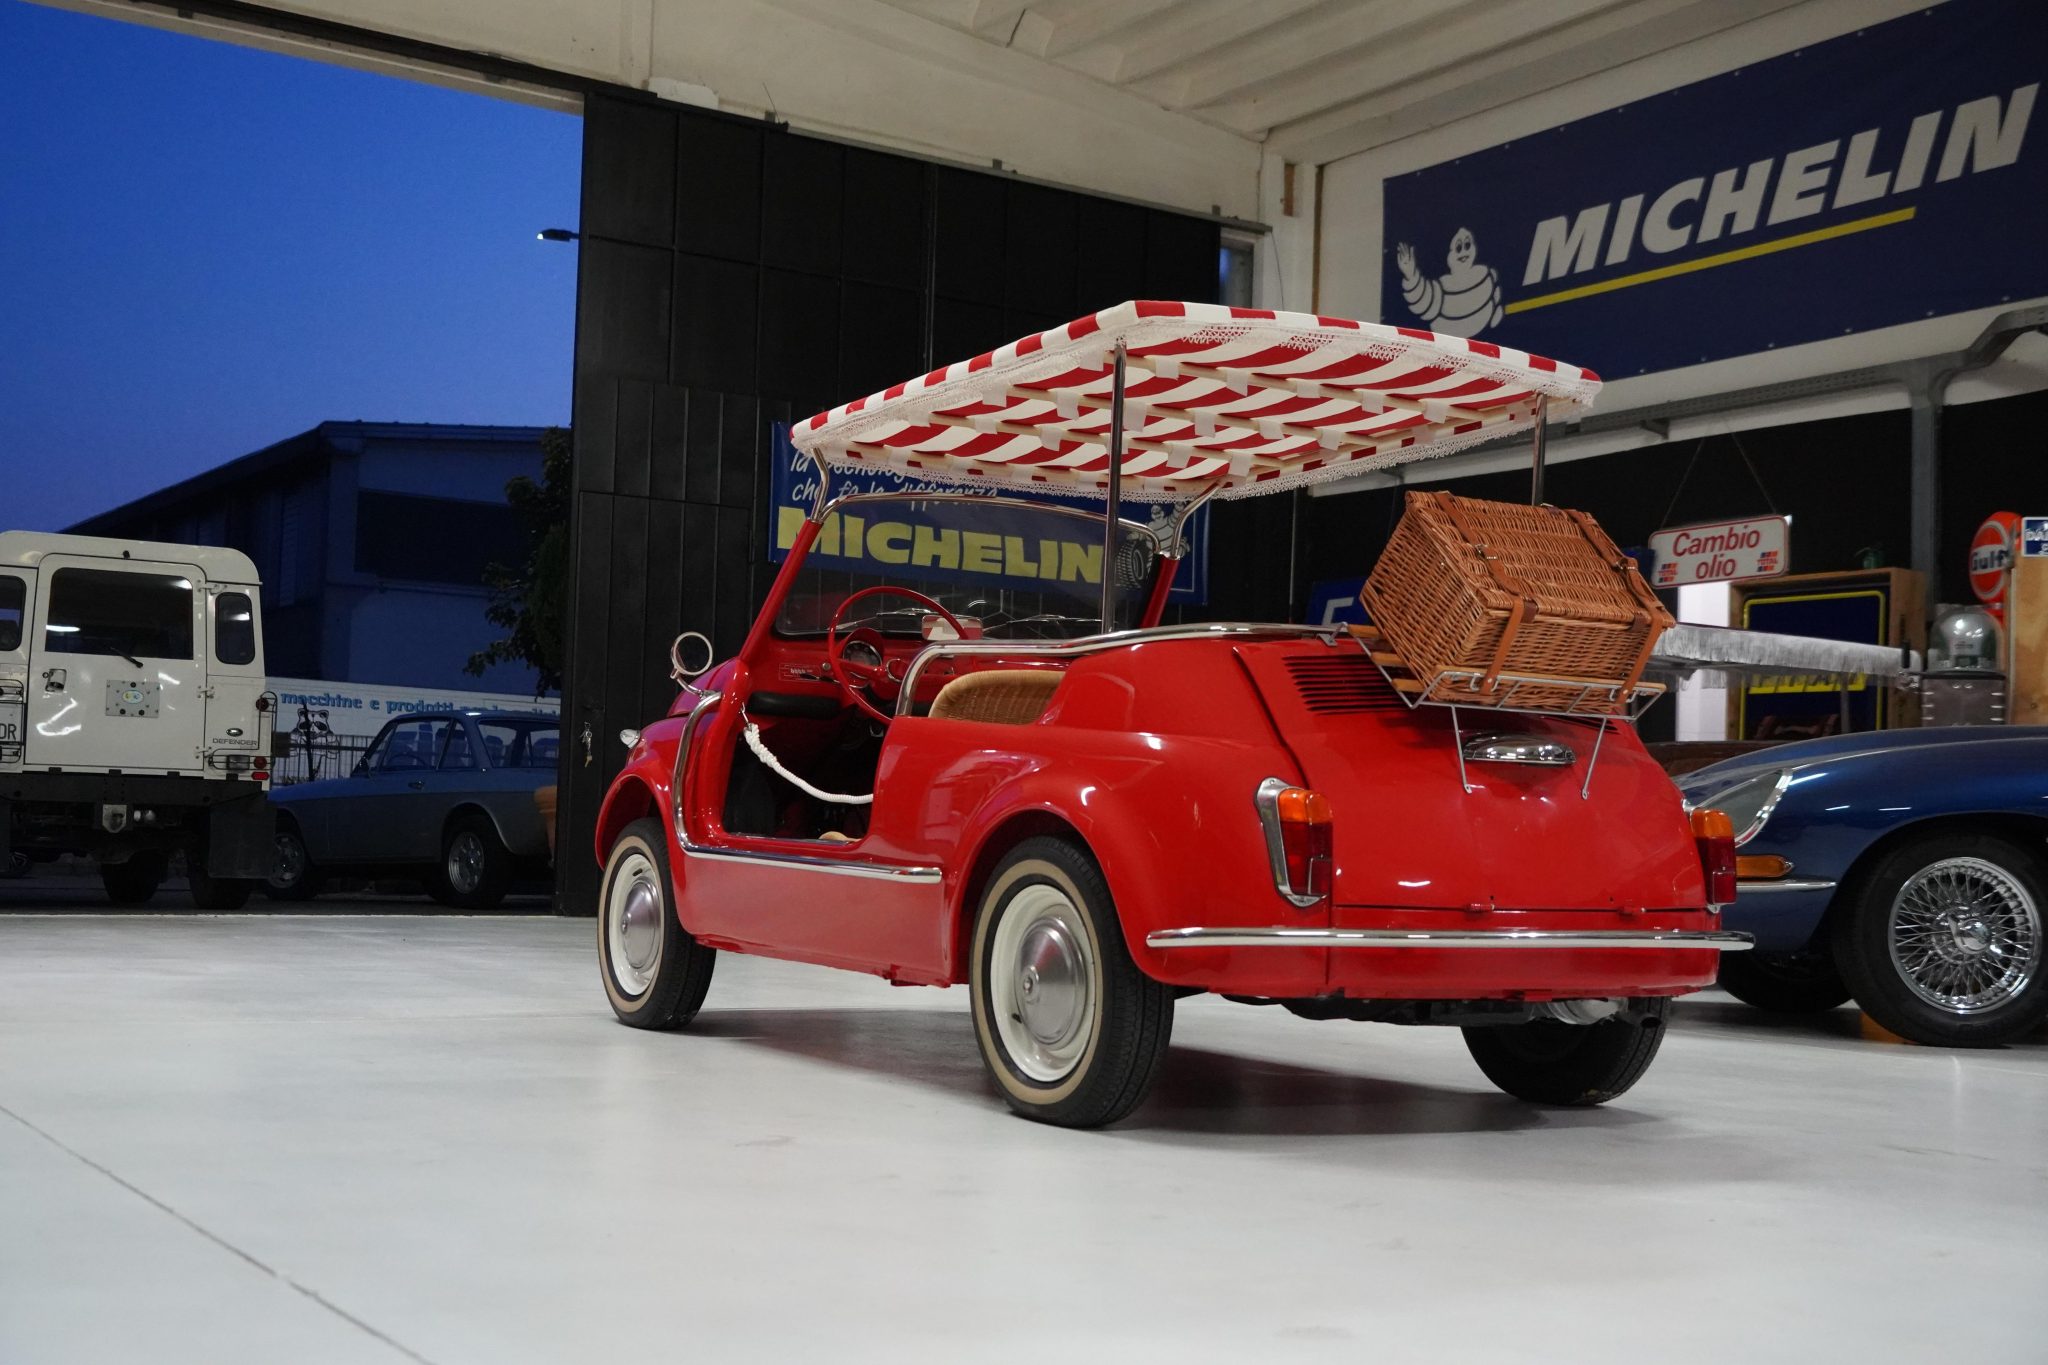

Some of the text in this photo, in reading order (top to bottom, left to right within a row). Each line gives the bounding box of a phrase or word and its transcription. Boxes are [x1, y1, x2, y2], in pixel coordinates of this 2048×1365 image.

[1522, 82, 2040, 286] MICHELIN
[777, 506, 1104, 584] MICHELIN
[1672, 525, 1760, 557] Cambio
[1696, 554, 1736, 579] olio
[281, 692, 363, 709] macchine
[369, 699, 380, 711] e
[212, 737, 258, 746] DEFENDER
